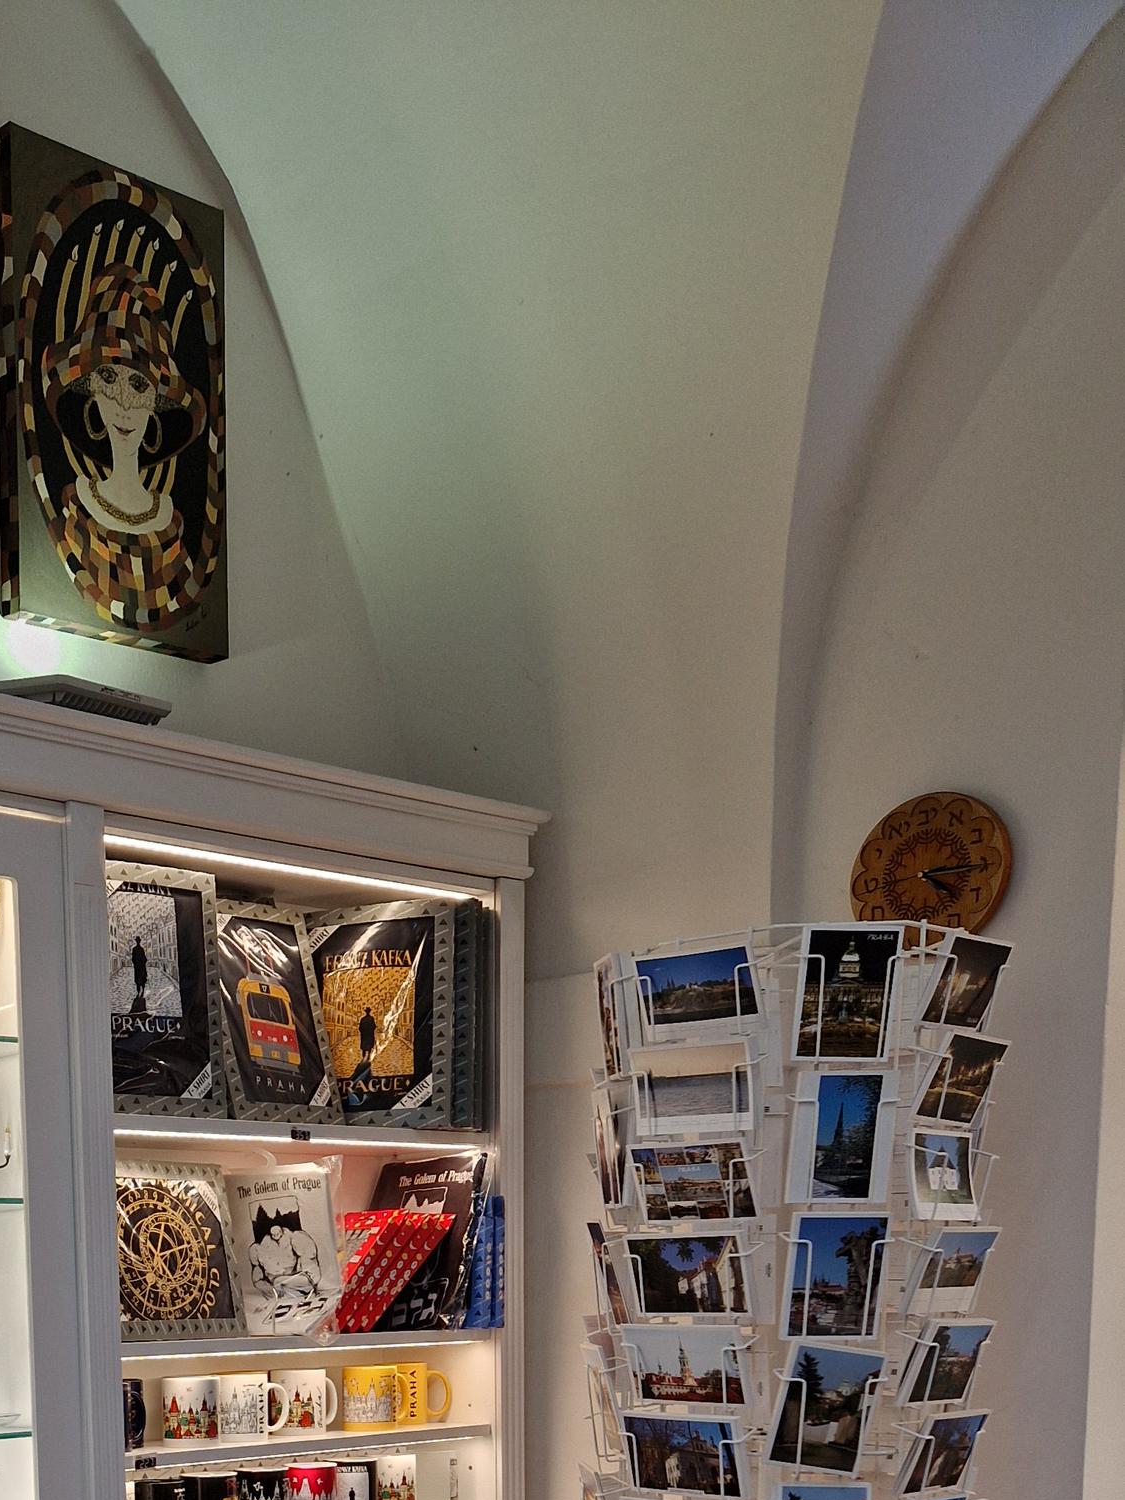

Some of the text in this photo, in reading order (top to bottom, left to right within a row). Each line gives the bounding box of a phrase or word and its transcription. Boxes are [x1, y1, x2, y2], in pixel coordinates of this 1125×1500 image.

[371, 949, 413, 966] KAFKA
[112, 1016, 175, 1033] PRAGUE
[256, 1076, 306, 1093] PRAHA
[237, 1177, 322, 1199] The Golem of Prague
[399, 1175, 413, 1188] The
[414, 1172, 437, 1184] Golem
[438, 1171, 447, 1182] of
